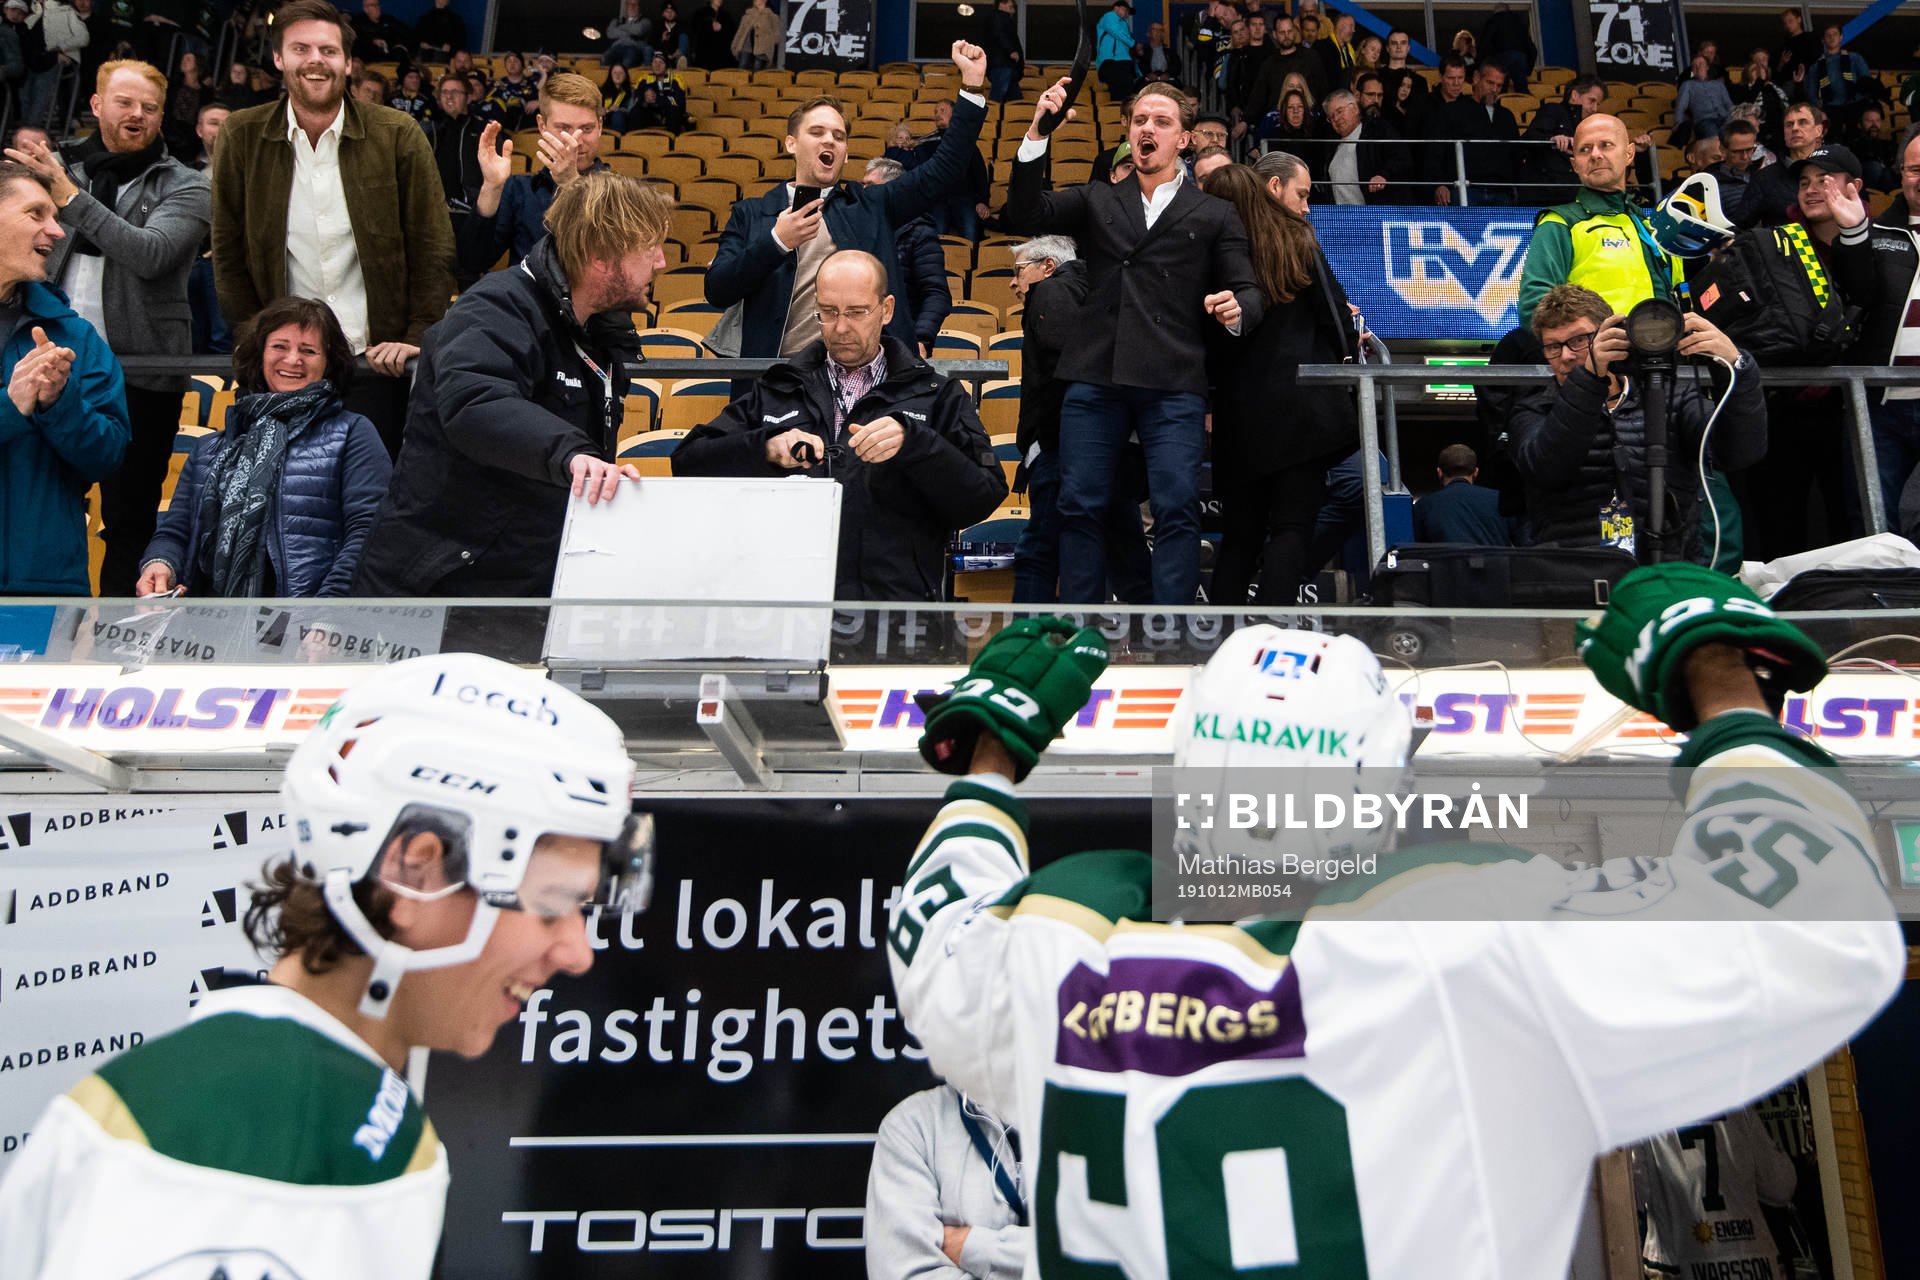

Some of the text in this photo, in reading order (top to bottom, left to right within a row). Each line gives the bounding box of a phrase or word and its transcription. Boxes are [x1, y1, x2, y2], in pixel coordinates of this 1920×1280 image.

[787, 0, 841, 34] 71
[1590, 3, 1645, 44] 71
[785, 32, 866, 58] ZONE
[1594, 42, 1674, 68] ZONE
[40, 686, 290, 732] HOLST
[1783, 695, 1908, 739] LST
[1192, 711, 1350, 758] KLARAVIK
[410, 764, 500, 795] CCM
[29, 871, 170, 911] ADDBRAND
[15, 950, 158, 991] ADDBRAND
[0, 1031, 145, 1073] ADDBRAND
